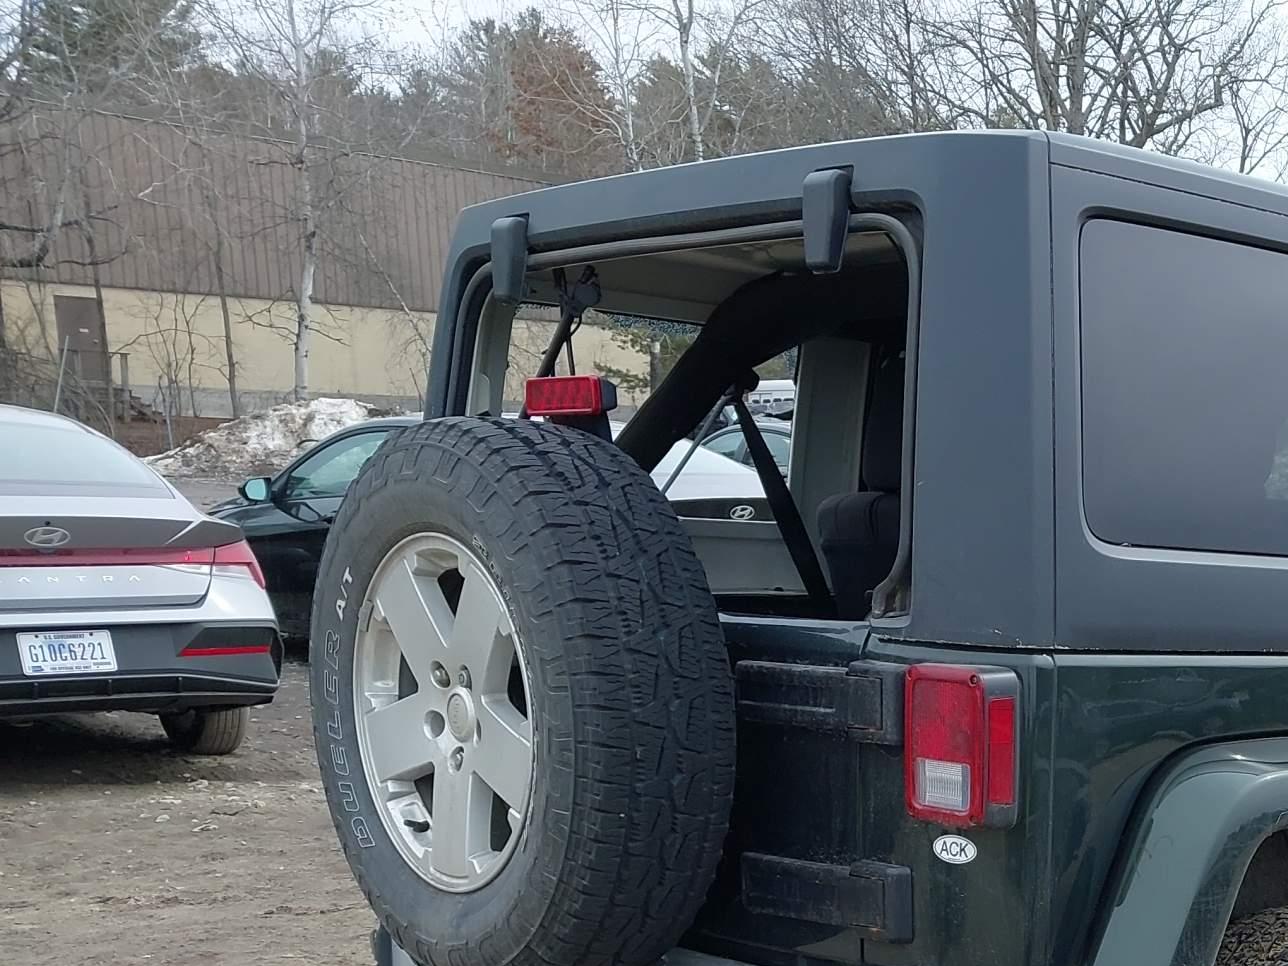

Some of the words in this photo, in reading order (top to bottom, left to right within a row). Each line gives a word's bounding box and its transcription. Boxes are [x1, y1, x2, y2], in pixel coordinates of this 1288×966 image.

[0, 574, 141, 584] ANTRA
[335, 566, 353, 622] A/T
[28, 642, 107, 663] G10C6221
[323, 629, 376, 849] DUELER
[940, 840, 968, 858] ACK
